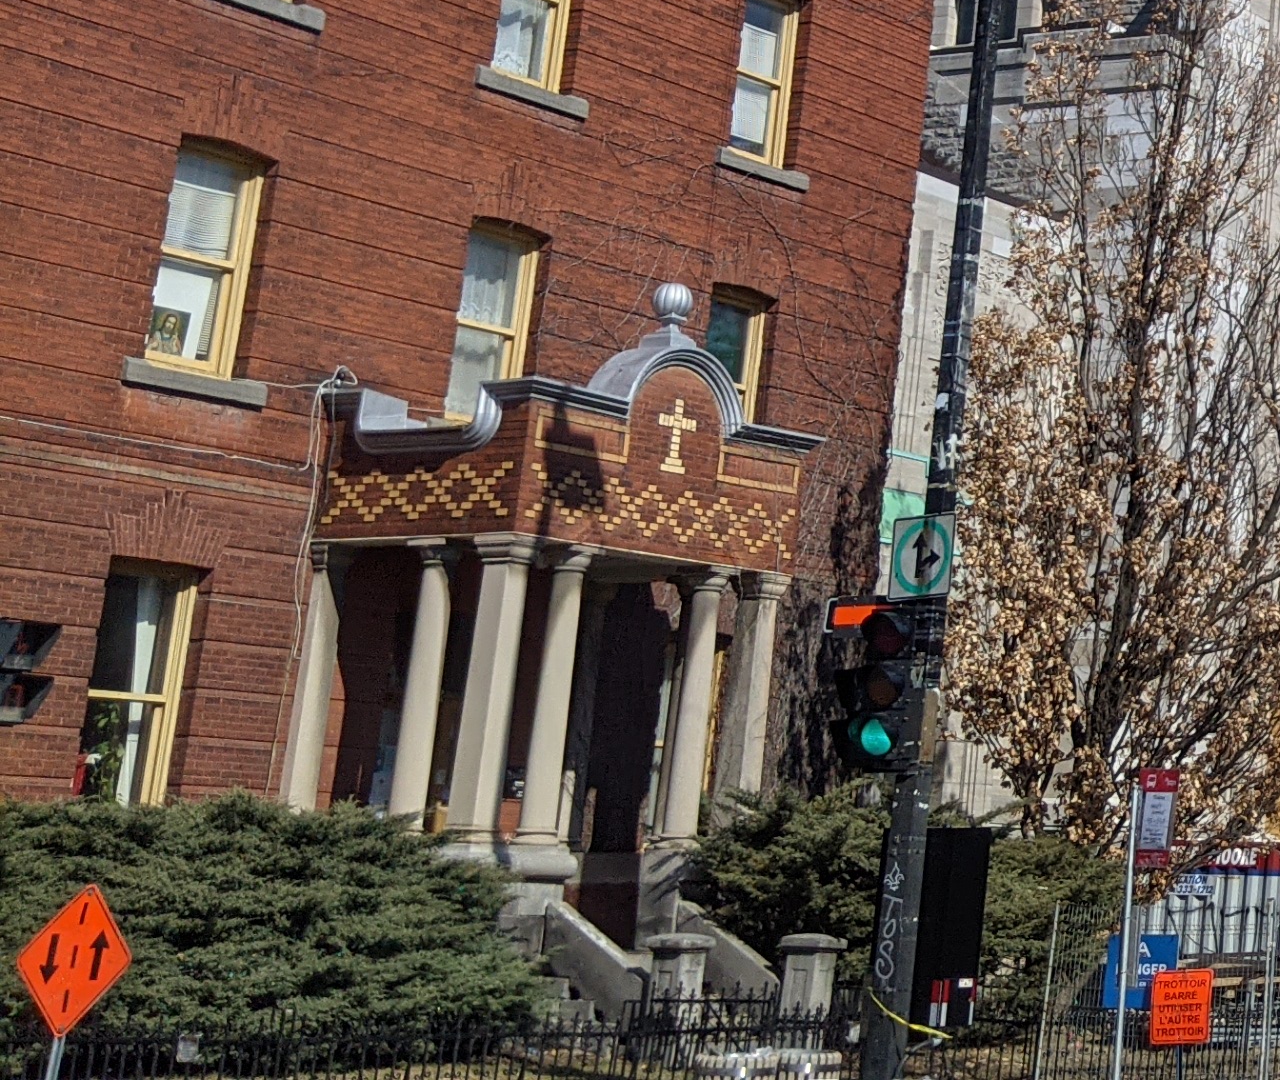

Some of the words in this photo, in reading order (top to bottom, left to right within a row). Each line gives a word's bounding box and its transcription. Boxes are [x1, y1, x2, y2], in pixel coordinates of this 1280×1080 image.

[1158, 980, 1207, 989] TROTTOIR
[1158, 1003, 1202, 1013] UTILISER
[1159, 1015, 1200, 1025] L'AUTRE
[1156, 1027, 1205, 1037] TROTTOIR
